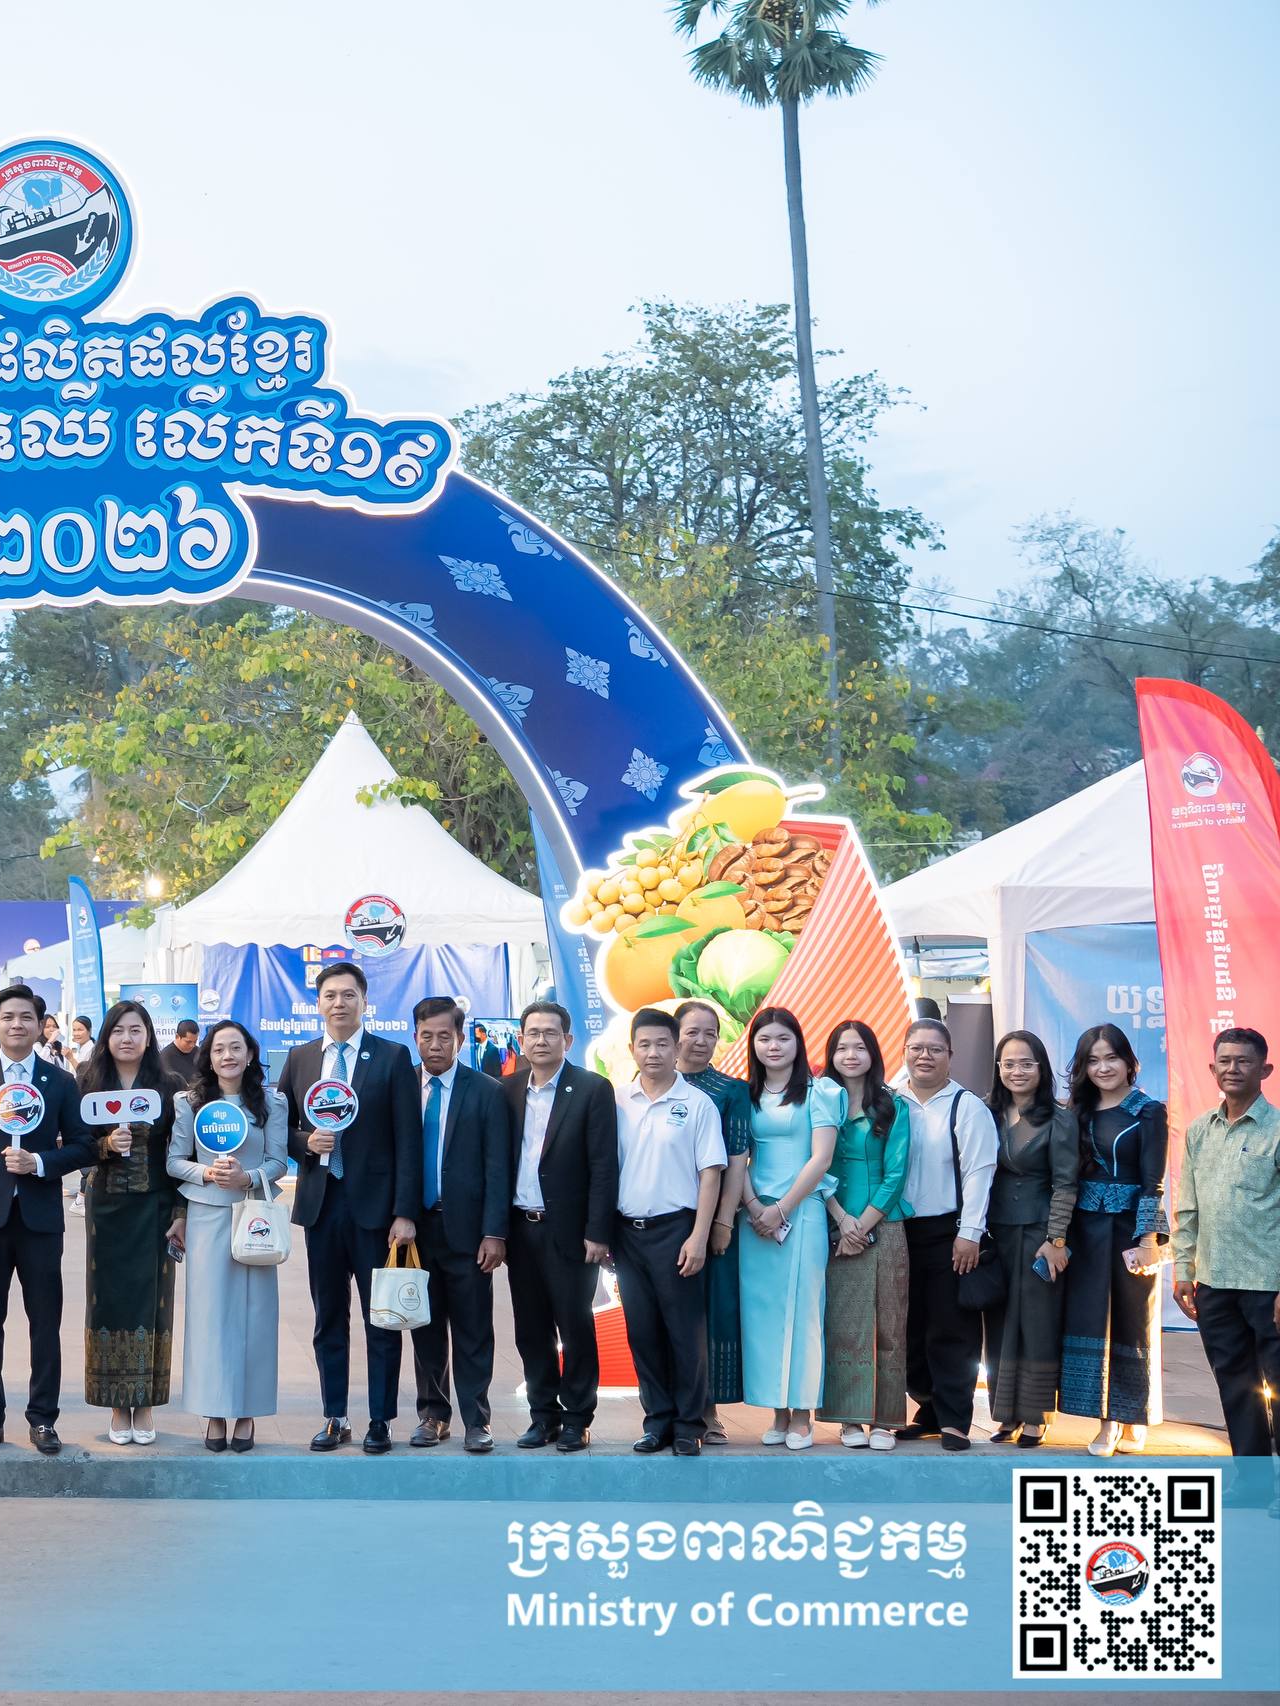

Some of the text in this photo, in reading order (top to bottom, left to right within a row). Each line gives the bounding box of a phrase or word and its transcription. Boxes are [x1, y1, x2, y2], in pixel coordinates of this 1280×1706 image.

[7, 257, 32, 270] MINISTRY
[42, 255, 72, 274] COMMERCE
[92, 1101, 97, 1117] I
